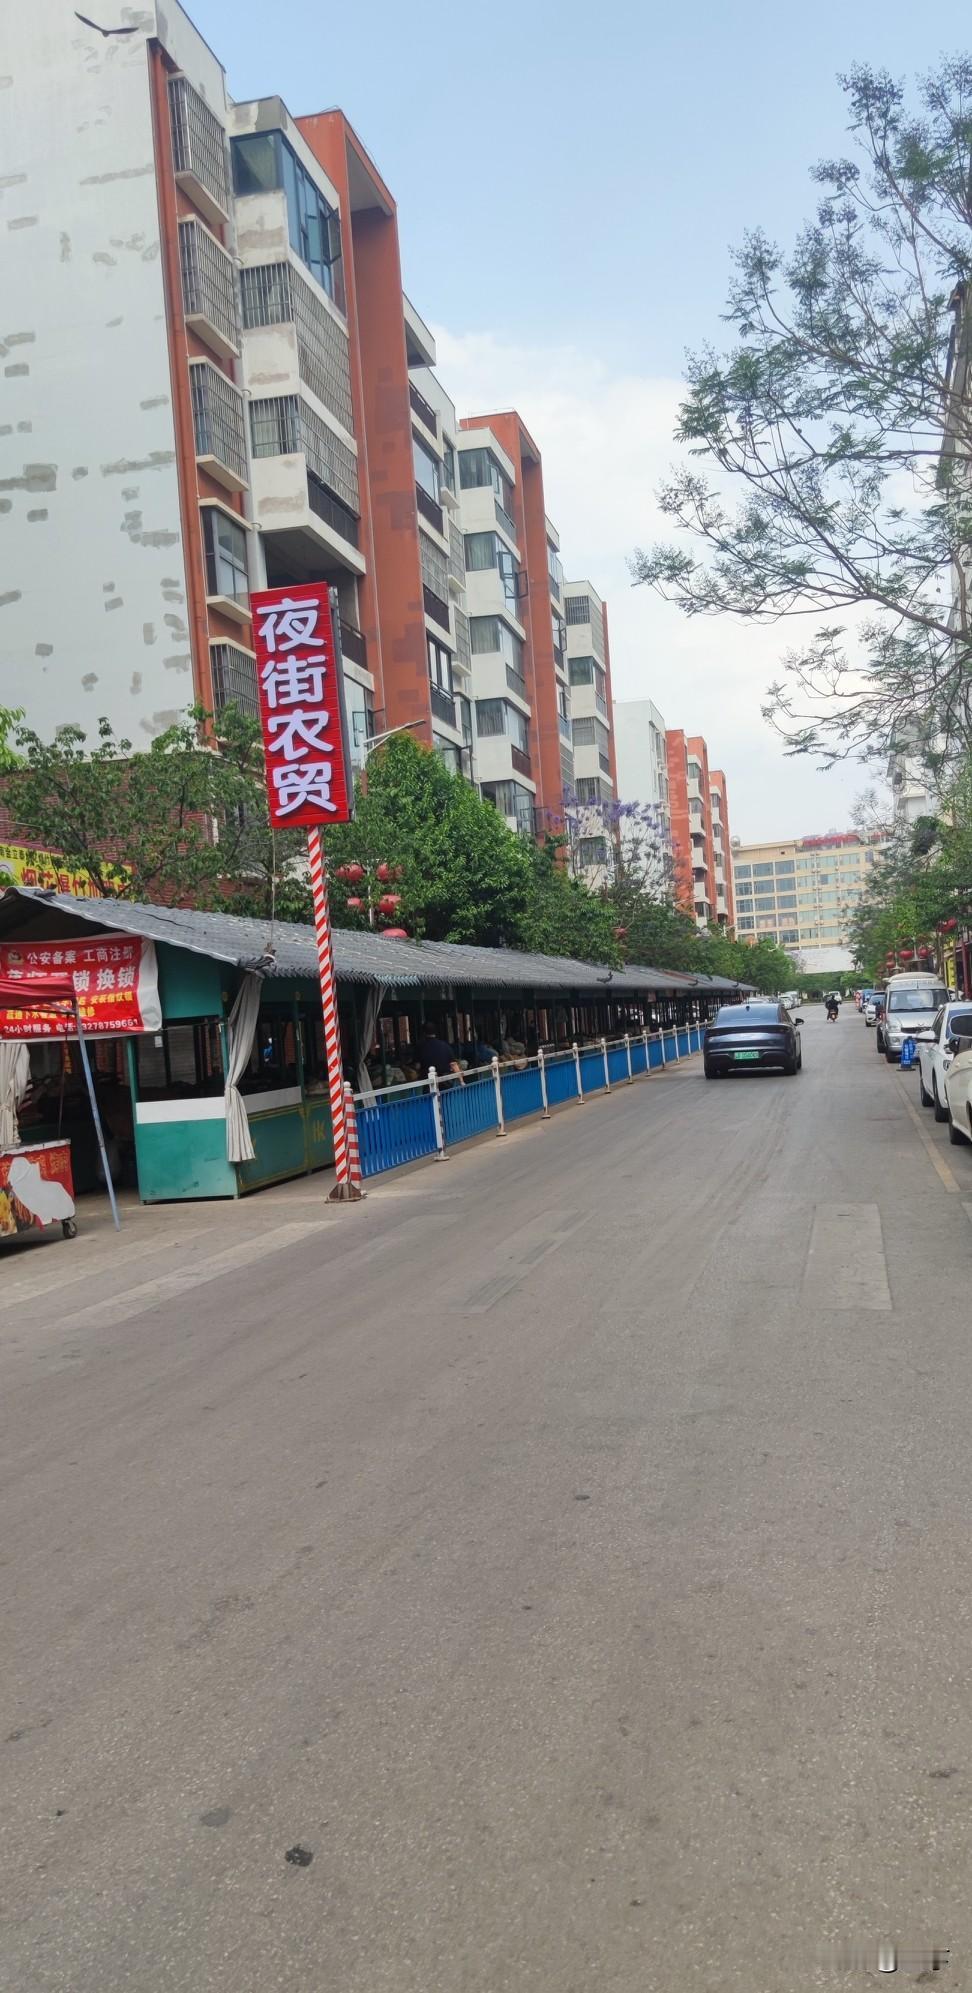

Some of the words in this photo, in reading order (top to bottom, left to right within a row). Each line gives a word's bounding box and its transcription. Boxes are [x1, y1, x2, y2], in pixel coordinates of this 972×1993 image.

[256, 597, 337, 817] 夜街农贸
[27, 951, 77, 965] 公安备案
[83, 946, 135, 963] 工商注册
